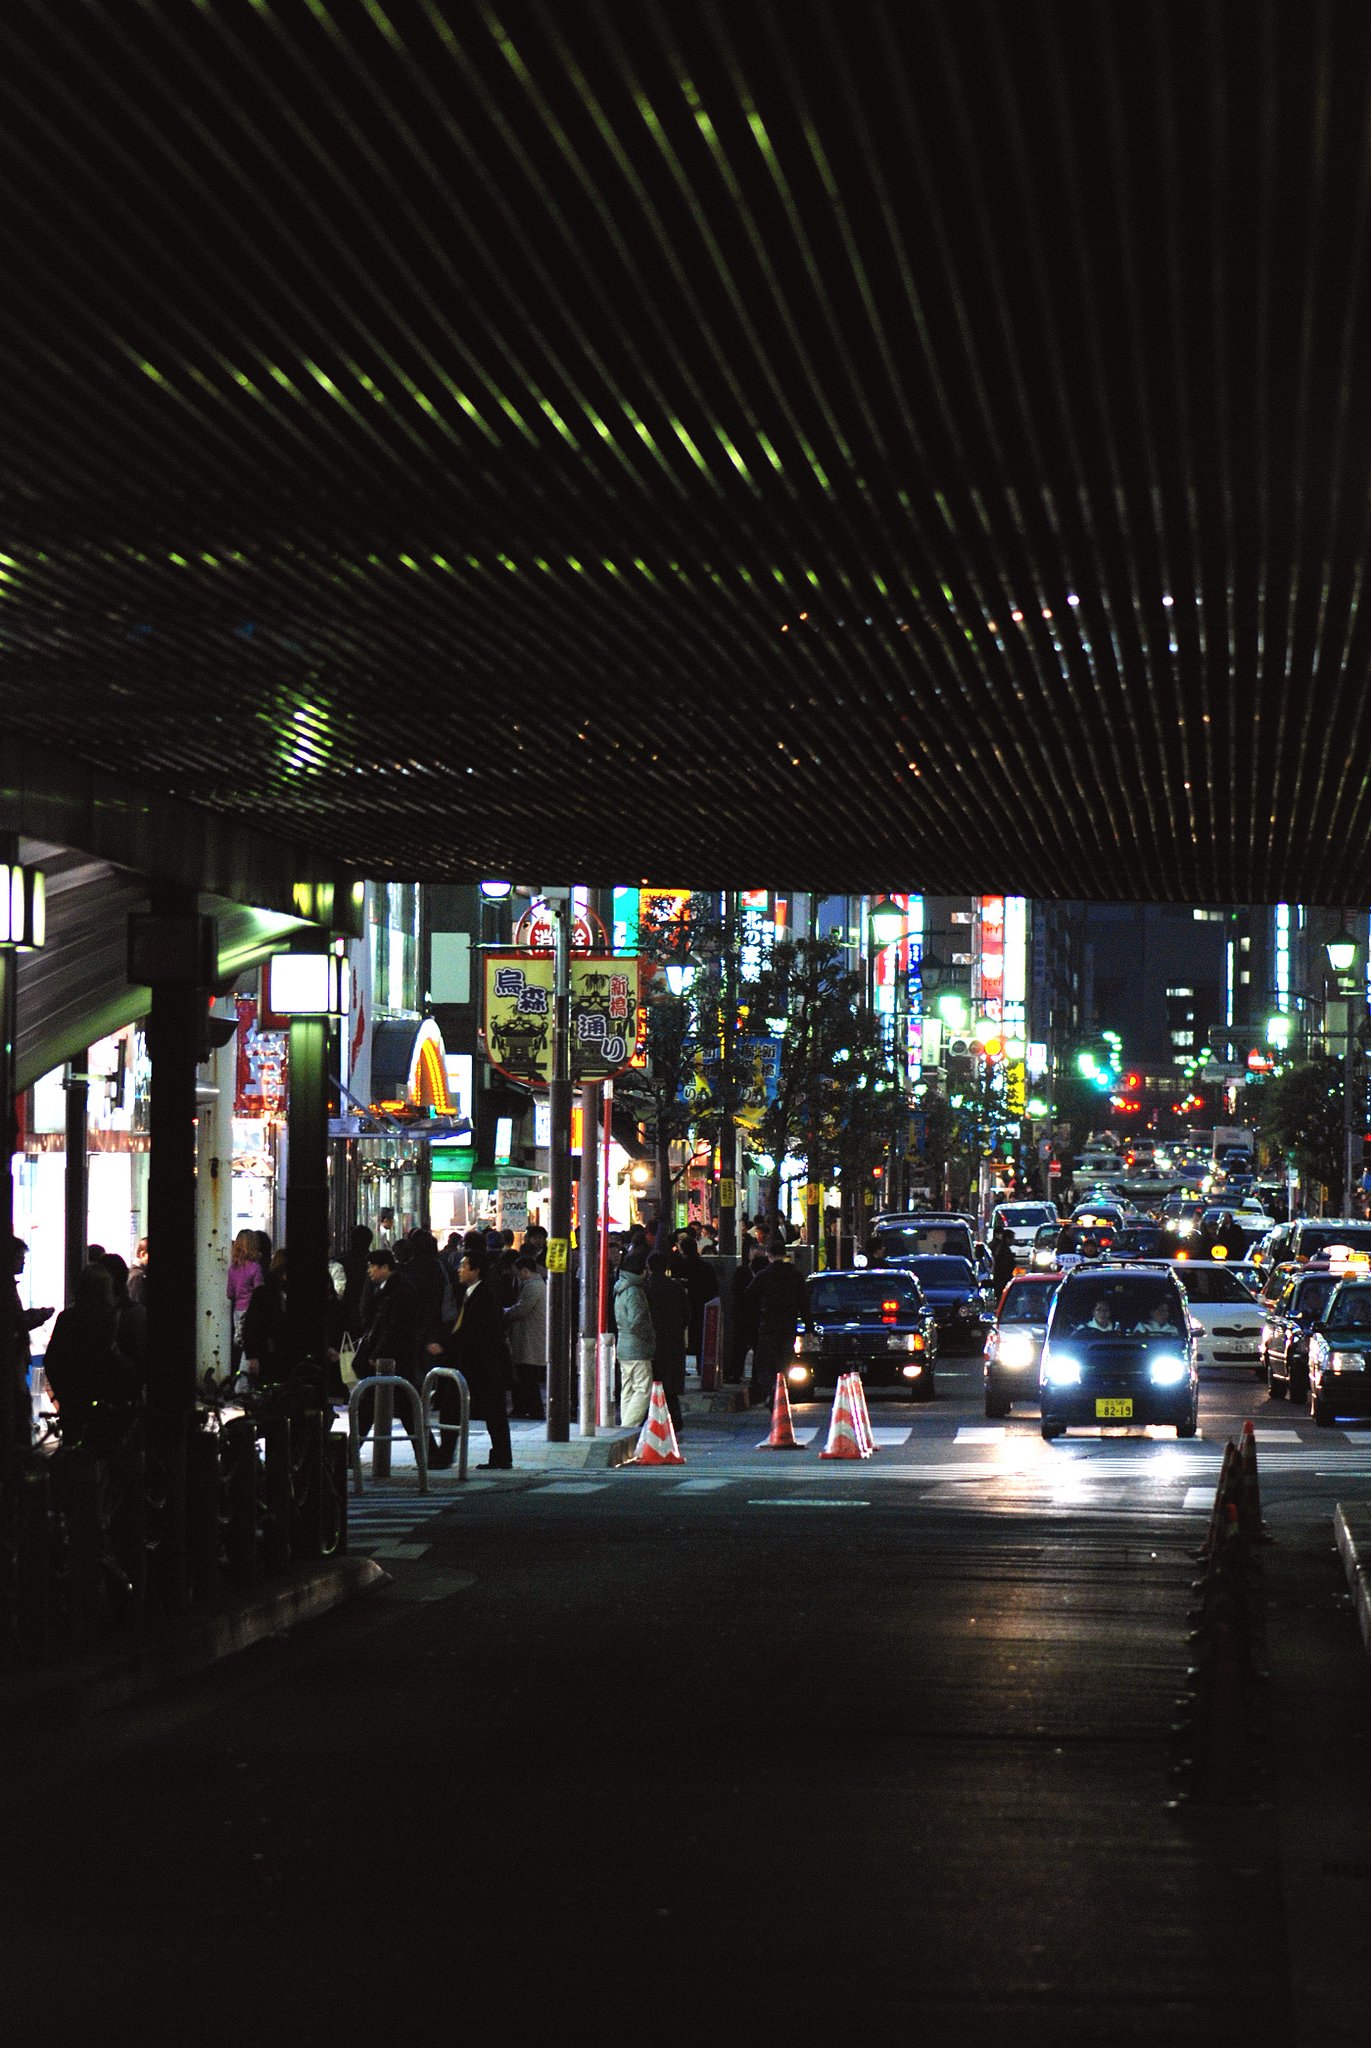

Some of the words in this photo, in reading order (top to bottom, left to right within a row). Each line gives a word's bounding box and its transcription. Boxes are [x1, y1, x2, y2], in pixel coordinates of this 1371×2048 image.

[534, 929, 587, 955] 消栓
[609, 975, 628, 1018] 新橋
[578, 1014, 627, 1062] 通り
[1104, 1406, 1131, 1416] 82-19
